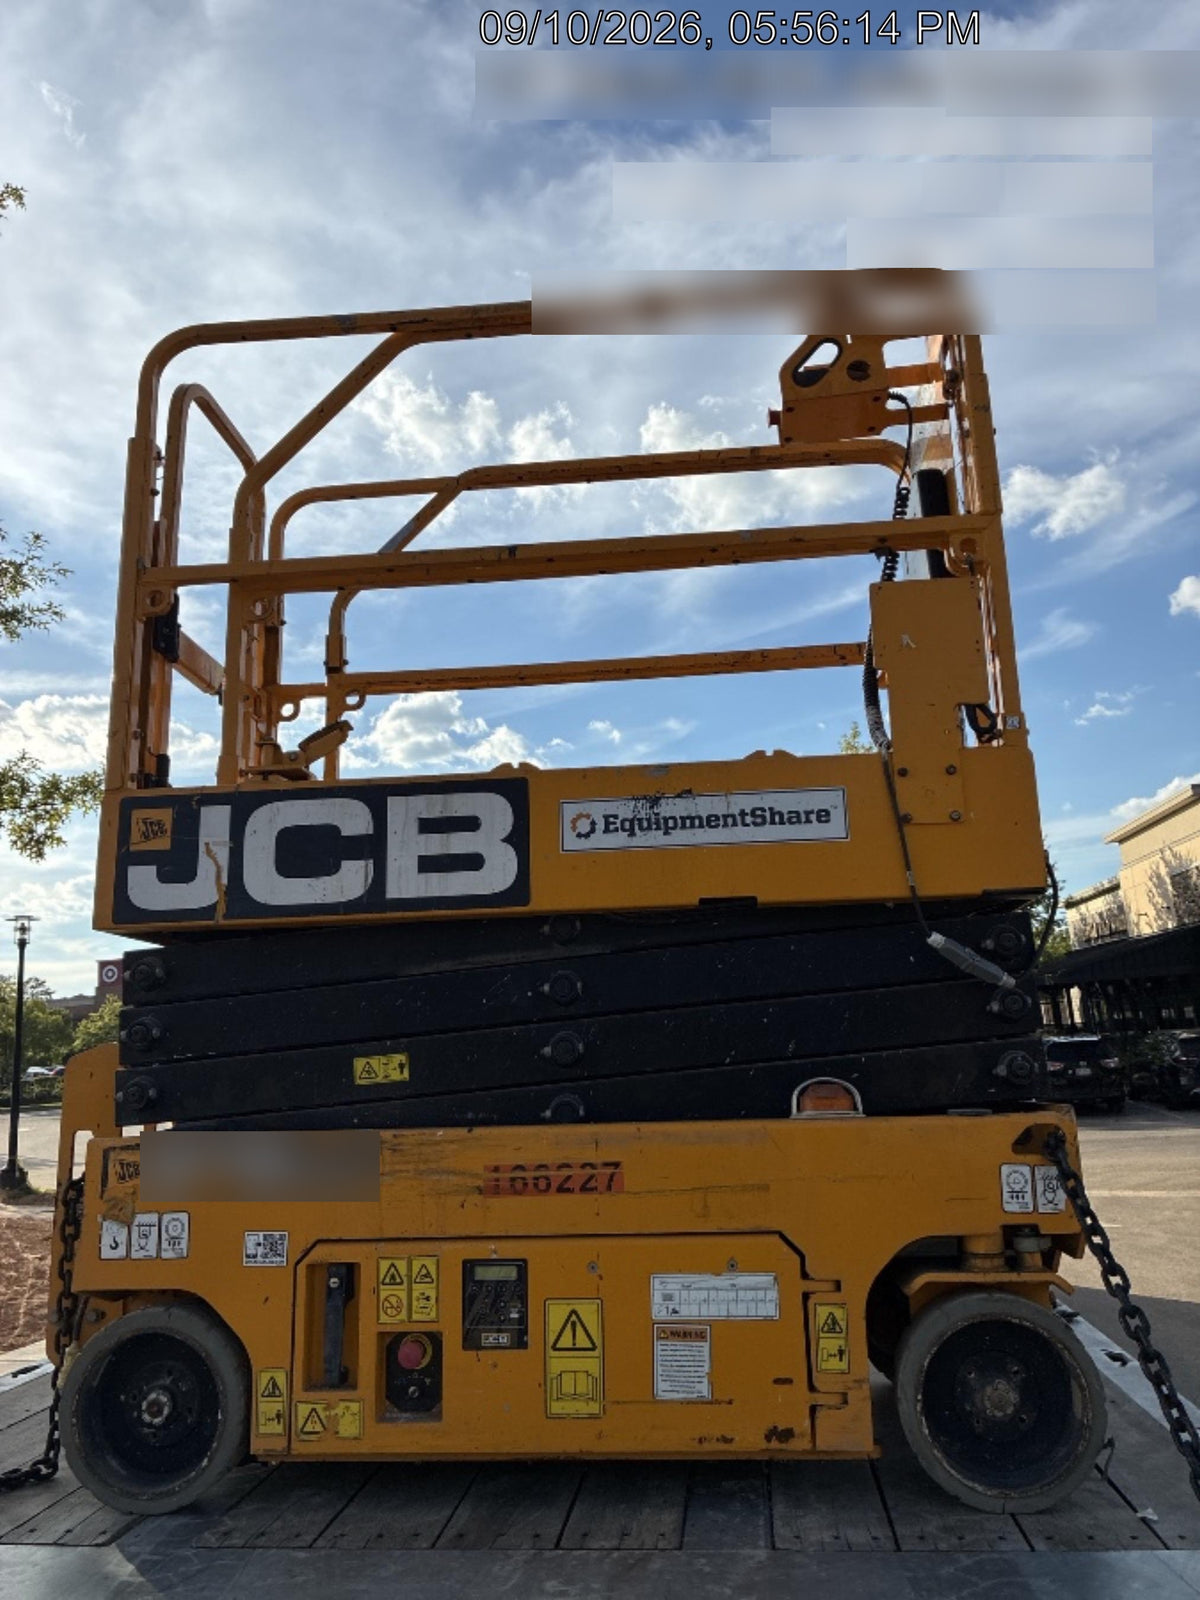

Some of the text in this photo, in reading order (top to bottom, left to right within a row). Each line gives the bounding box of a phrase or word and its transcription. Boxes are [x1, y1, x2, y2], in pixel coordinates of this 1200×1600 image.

[140, 817, 167, 841] JCB
[602, 805, 832, 837] EquipmentShare
[128, 792, 518, 911] JCB
